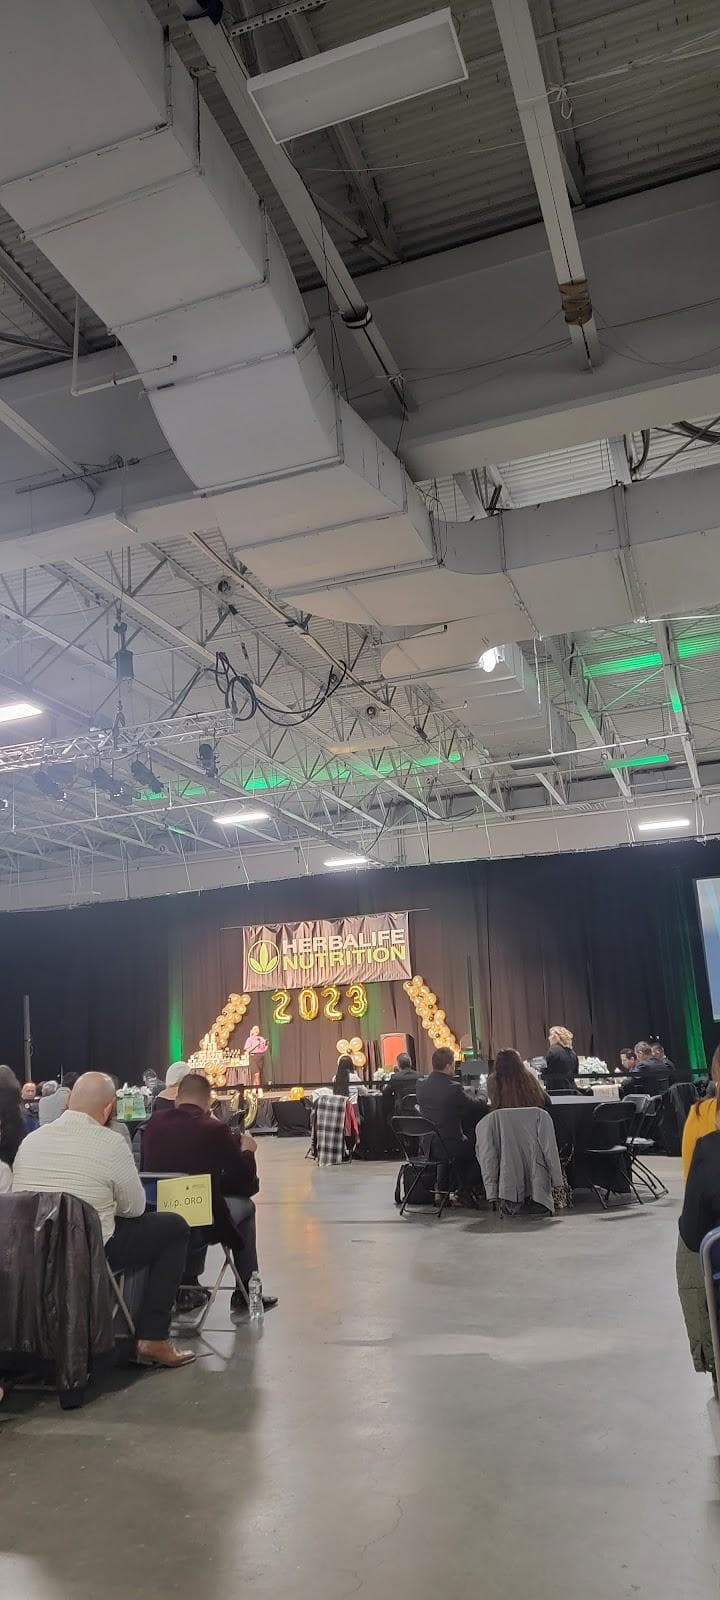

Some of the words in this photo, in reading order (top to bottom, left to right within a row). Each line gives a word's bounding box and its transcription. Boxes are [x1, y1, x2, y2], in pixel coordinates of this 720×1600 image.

[282, 929, 405, 954] HERBALIFE
[282, 945, 406, 971] NUTRITION
[271, 983, 368, 1024] 2023
[184, 1196, 203, 1206] ORO
